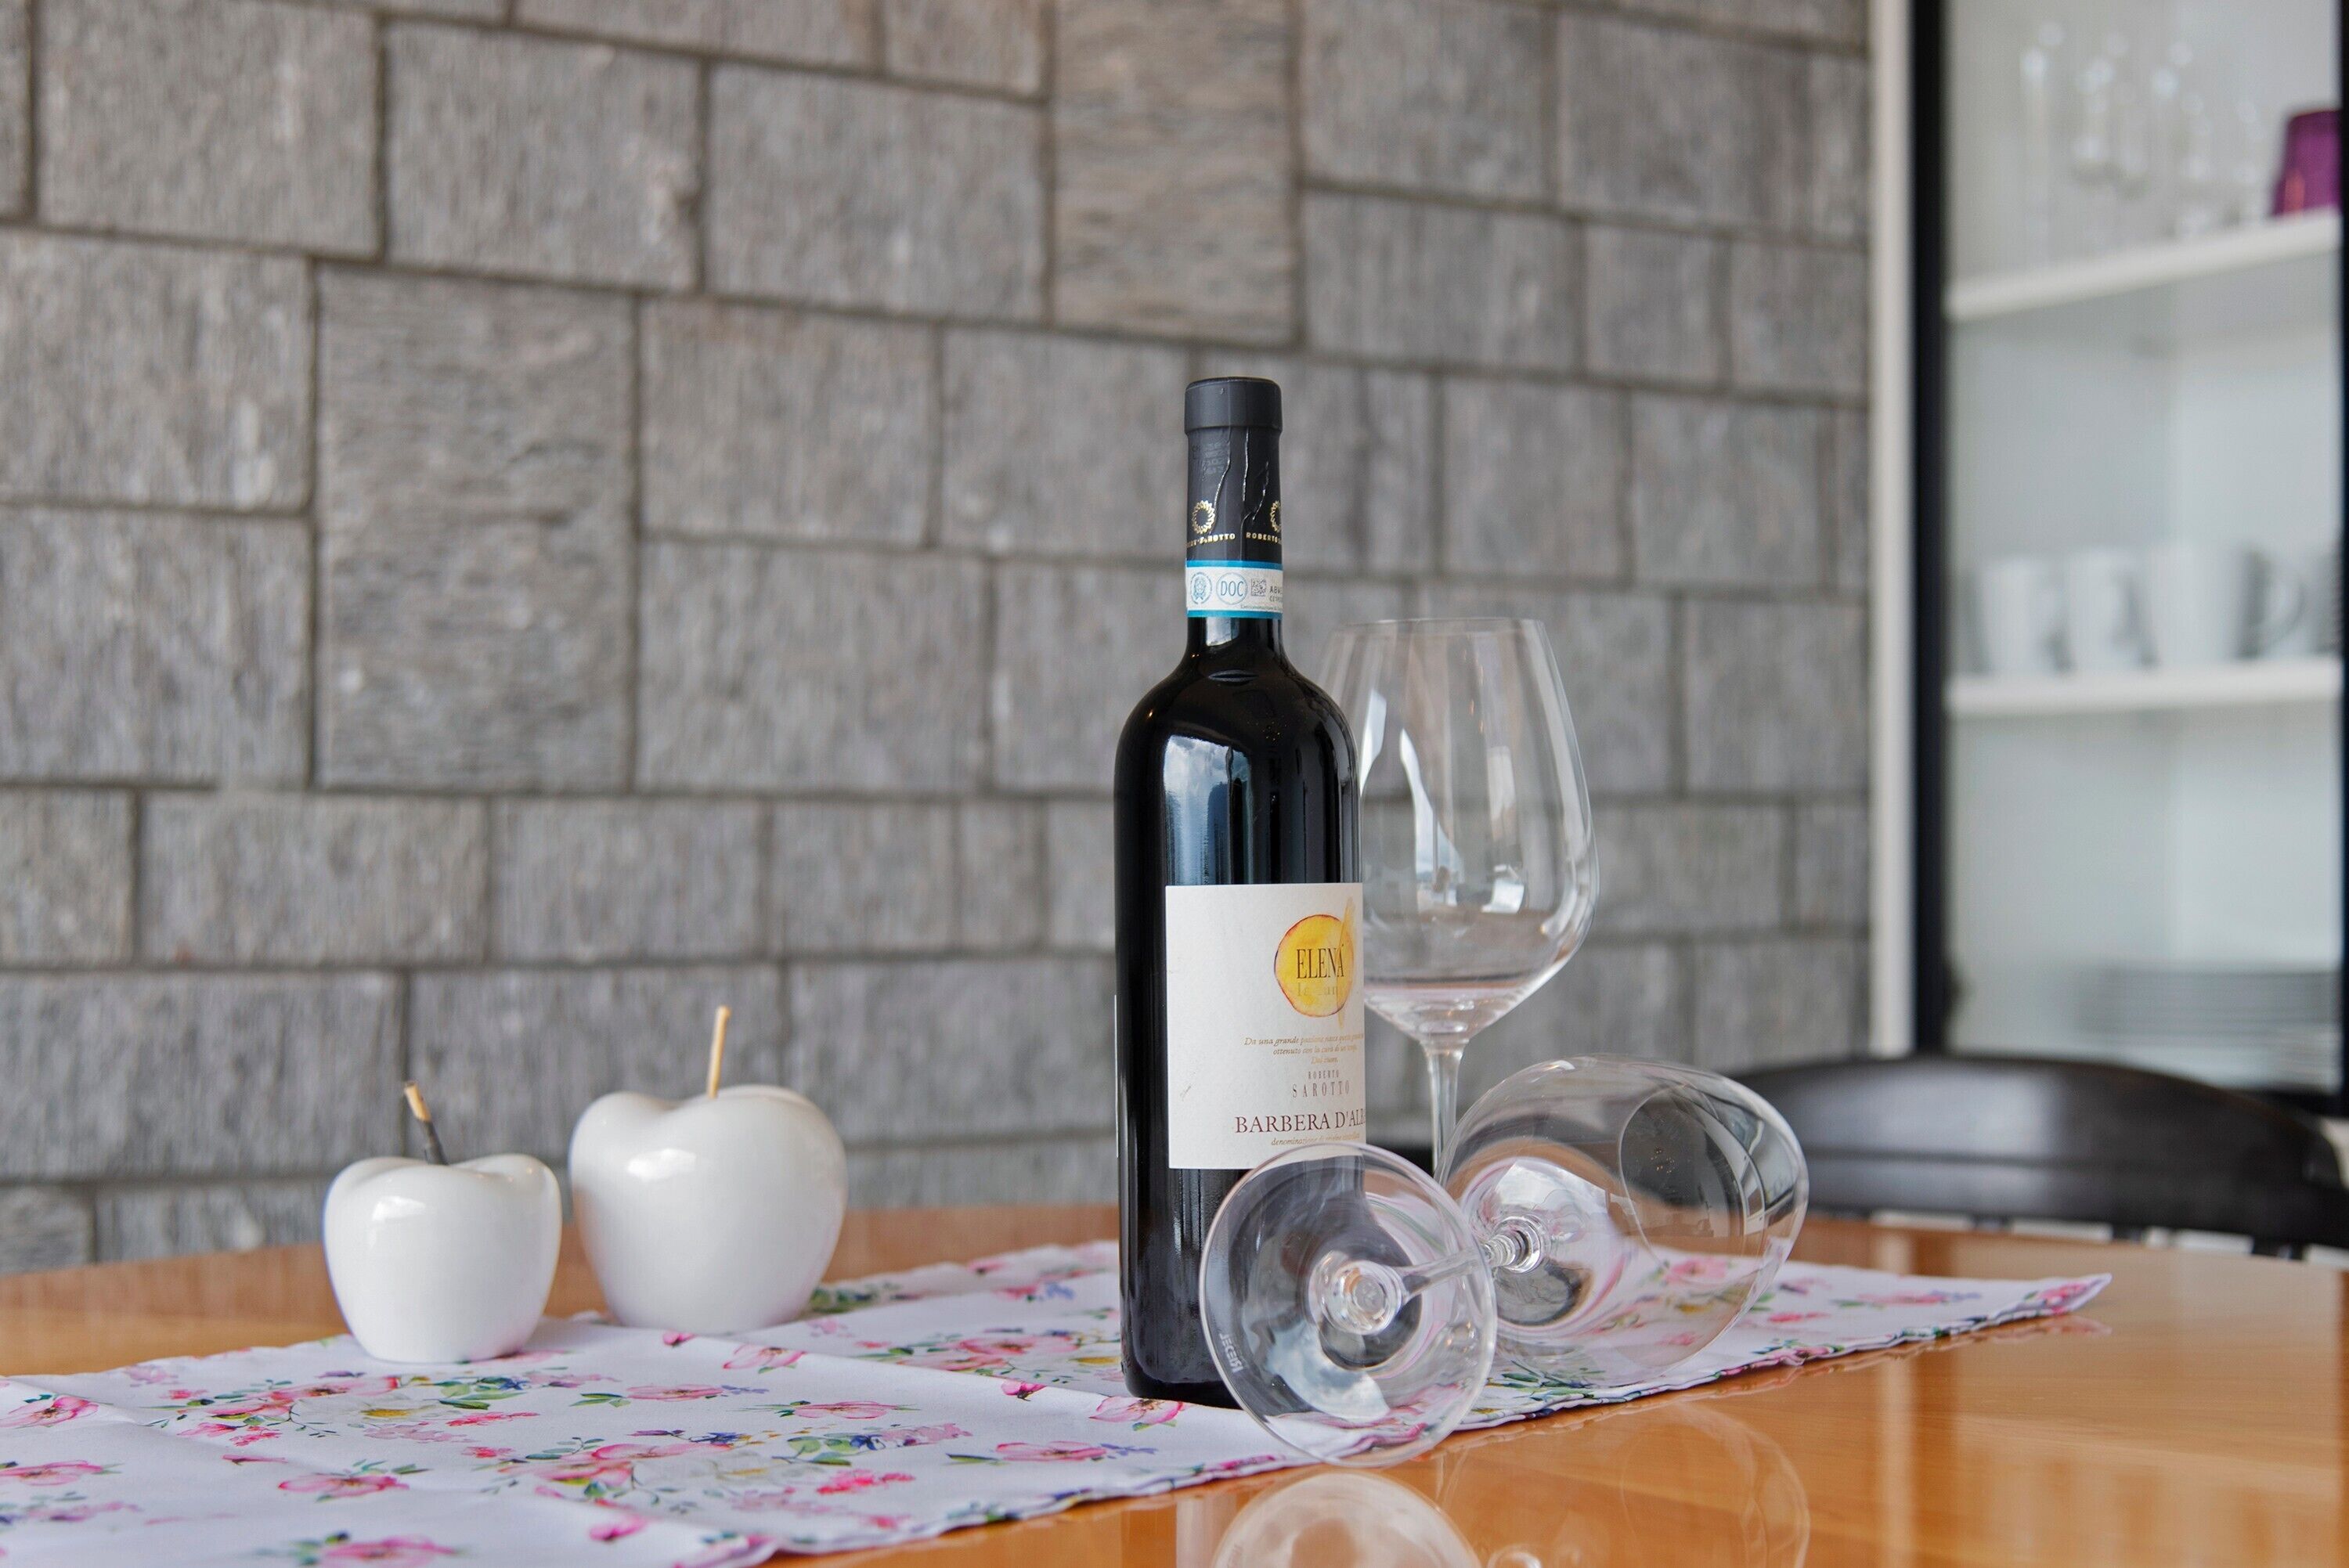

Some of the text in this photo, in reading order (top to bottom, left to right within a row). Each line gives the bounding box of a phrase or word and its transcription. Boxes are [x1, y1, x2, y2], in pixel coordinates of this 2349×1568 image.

[1246, 532, 1278, 543] ROBERTO
[1221, 581, 1244, 597] DOC
[1274, 1036, 1300, 1047] grande
[1308, 1069, 1340, 1080] ROBERTO
[1292, 1080, 1350, 1098] SAROTTO
[1235, 1112, 1331, 1134] BARBERA
